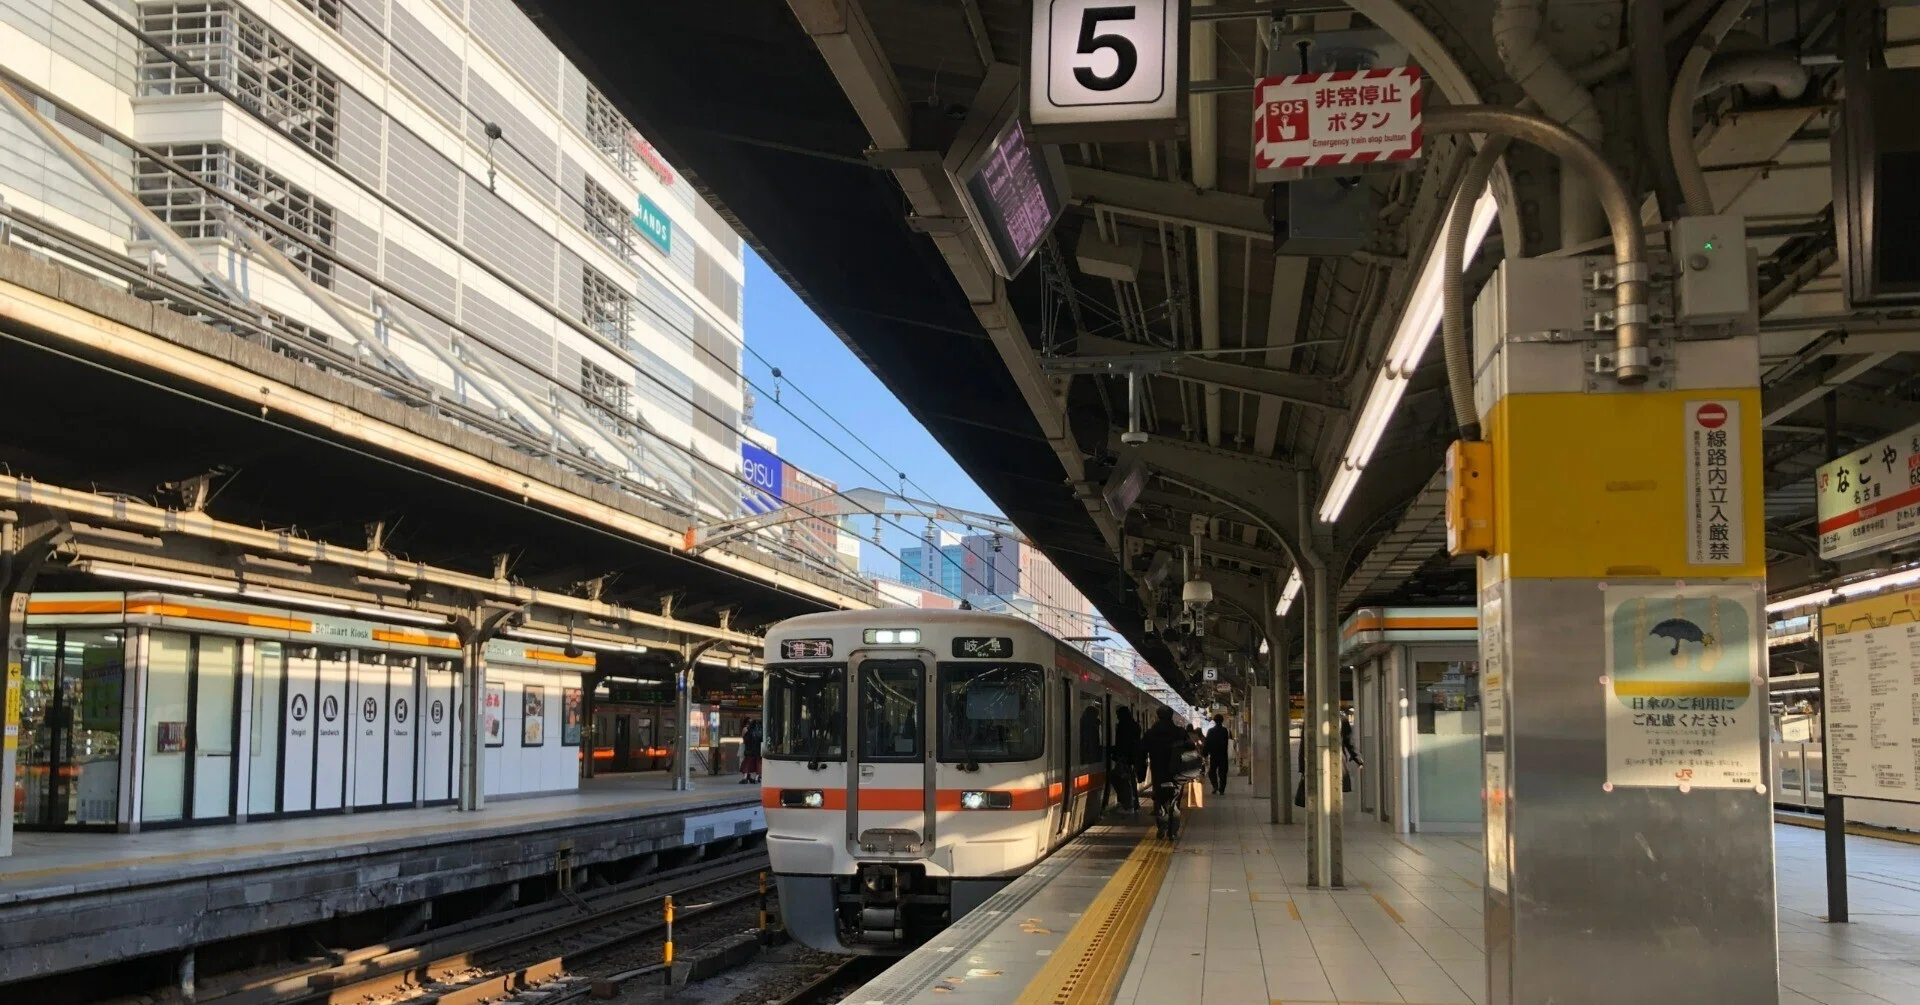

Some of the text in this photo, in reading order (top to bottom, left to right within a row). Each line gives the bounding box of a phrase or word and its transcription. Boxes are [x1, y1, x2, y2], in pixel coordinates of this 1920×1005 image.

[1072, 5, 1138, 91] 5
[1316, 83, 1402, 109] 非常停止
[1270, 101, 1305, 116] SOS
[1327, 111, 1391, 132] ボタン
[1312, 134, 1407, 148] Emergency train stop button
[1837, 444, 1897, 493] なごや
[1706, 429, 1730, 560] 線路内立入厳禁
[1854, 482, 1881, 504] 名古屋
[315, 622, 369, 639] Bellmart Kiosk
[793, 641, 829, 657] 普通
[964, 638, 1002, 653] 岐阜
[1207, 669, 1214, 679] 5
[1632, 696, 1735, 711] 日傘のご利用に
[1632, 713, 1736, 728] ご配慮ください
[320, 728, 340, 736] Sandwich
[1675, 768, 1693, 779] JR
